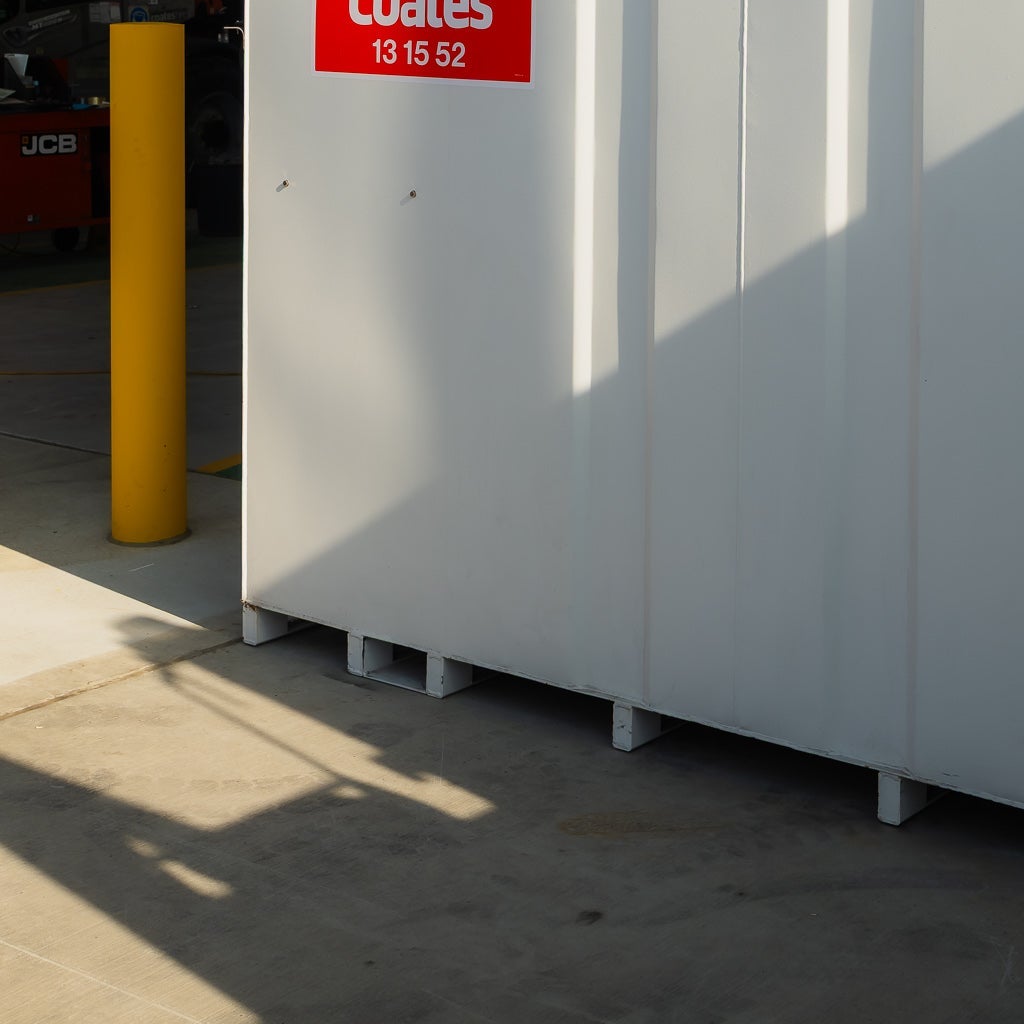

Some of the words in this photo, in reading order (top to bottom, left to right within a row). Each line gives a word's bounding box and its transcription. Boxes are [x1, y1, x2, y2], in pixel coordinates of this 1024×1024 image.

[372, 38, 397, 64] 13
[404, 40, 429, 66] 15
[435, 41, 466, 68] 52
[21, 133, 77, 156] JCB
